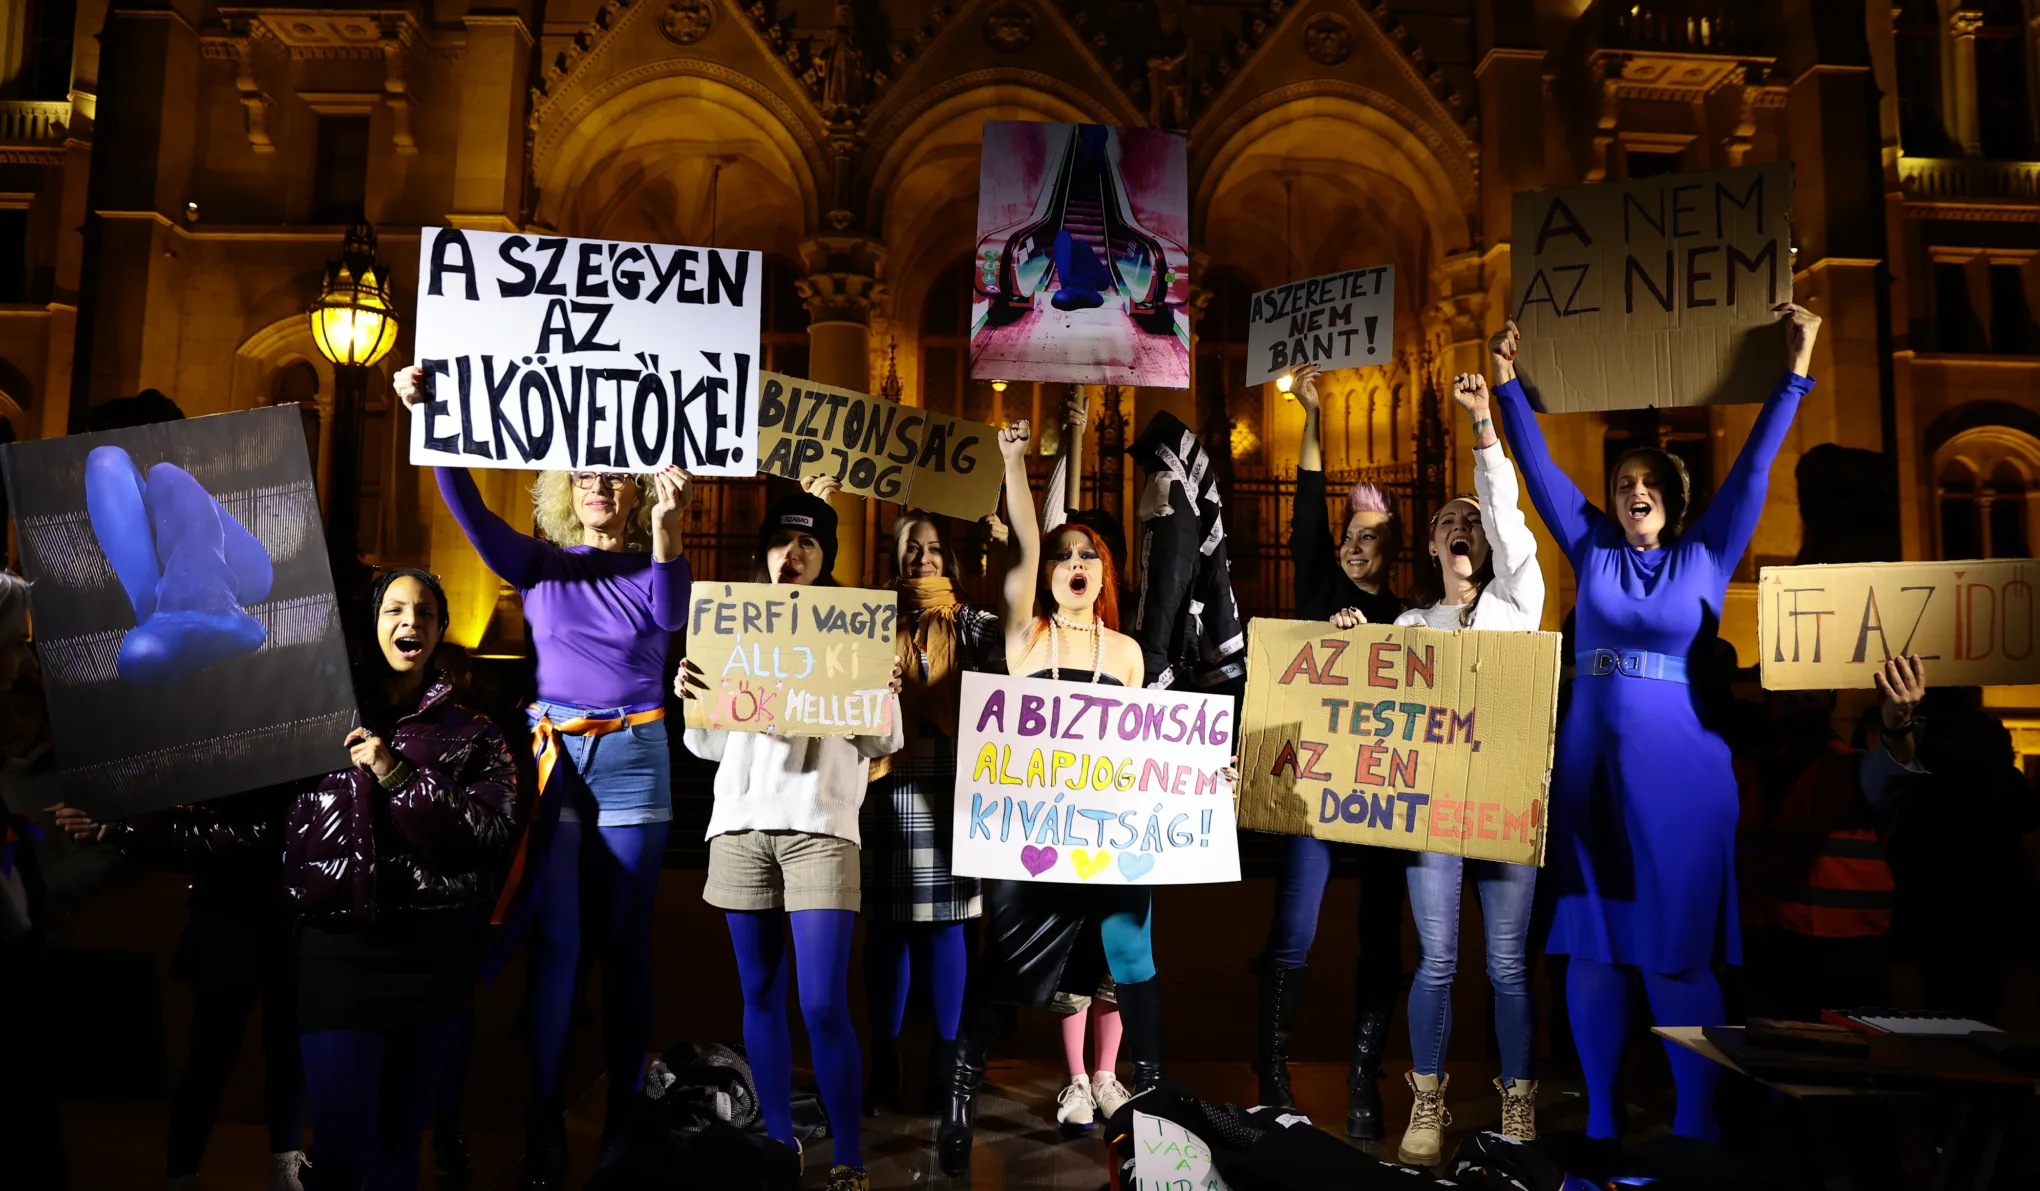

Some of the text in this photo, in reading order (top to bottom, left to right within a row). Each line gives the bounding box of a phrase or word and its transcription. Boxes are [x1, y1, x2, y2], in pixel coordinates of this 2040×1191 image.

[1533, 173, 1764, 255] A NEM
[427, 228, 750, 307] A SZÉGYEN
[1516, 238, 1777, 322] AZ NEM
[535, 298, 621, 355] AZ
[1288, 303, 1353, 338] NEM
[758, 379, 979, 474] BIZTONSÁG
[812, 602, 898, 643] VAGY?
[1846, 585, 1941, 663] AZ
[1278, 634, 1434, 689] AZ ÉN
[976, 689, 1230, 746] A BIZTONSÁG
[972, 742, 1218, 795] ALAPJOG NEM
[1270, 738, 1419, 788] AZ ÉN
[969, 792, 1213, 853] KIVÁLTSÁG!
[1175, 1159, 1192, 1171] A
